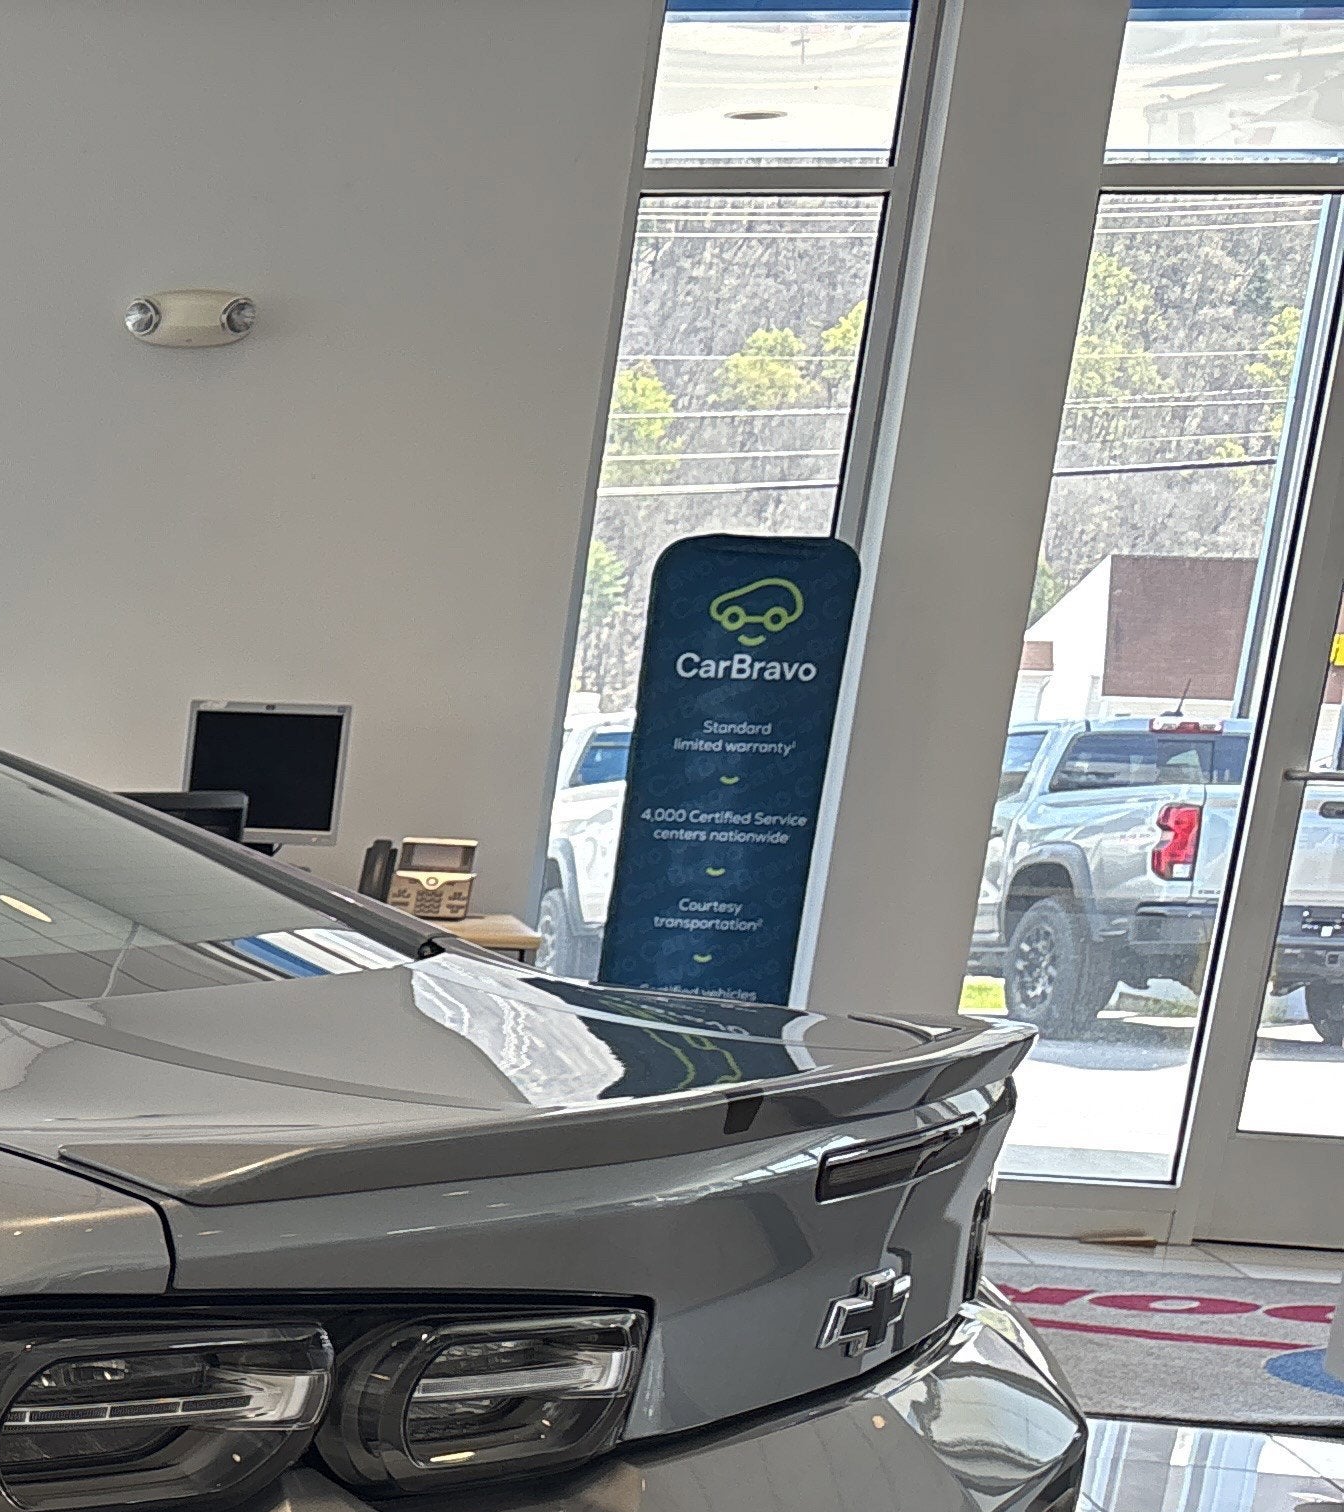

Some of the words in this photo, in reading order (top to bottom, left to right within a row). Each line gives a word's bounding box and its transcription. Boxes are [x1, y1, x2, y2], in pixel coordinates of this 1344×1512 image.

[676, 651, 818, 682] CarBravo
[702, 719, 773, 736] Standard
[673, 737, 723, 752] limited
[640, 807, 687, 822] 4,000
[689, 809, 752, 825] Certified
[754, 811, 808, 827] Service
[653, 828, 706, 842] centers
[709, 829, 790, 844] nationwide
[678, 898, 744, 916] Courtesy
